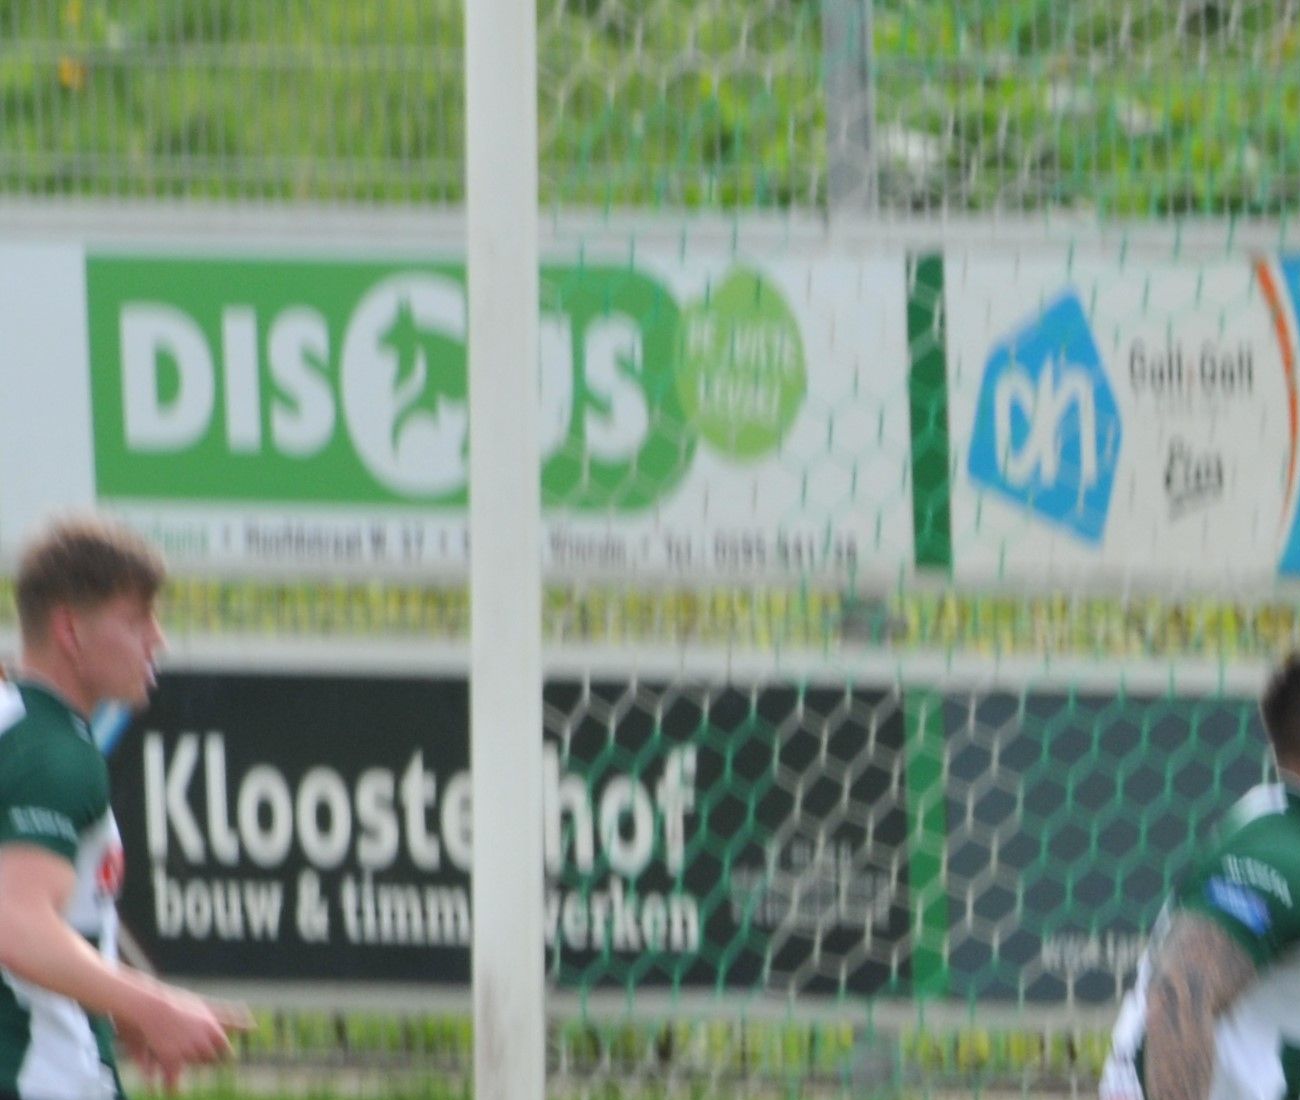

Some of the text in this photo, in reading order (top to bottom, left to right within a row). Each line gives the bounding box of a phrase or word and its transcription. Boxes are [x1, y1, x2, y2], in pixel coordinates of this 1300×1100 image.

[118, 272, 652, 500] DISCS
[143, 730, 697, 878] Kloostehof
[152, 863, 284, 942] bouw
[298, 872, 331, 944] &
[341, 870, 700, 953] timmerken
